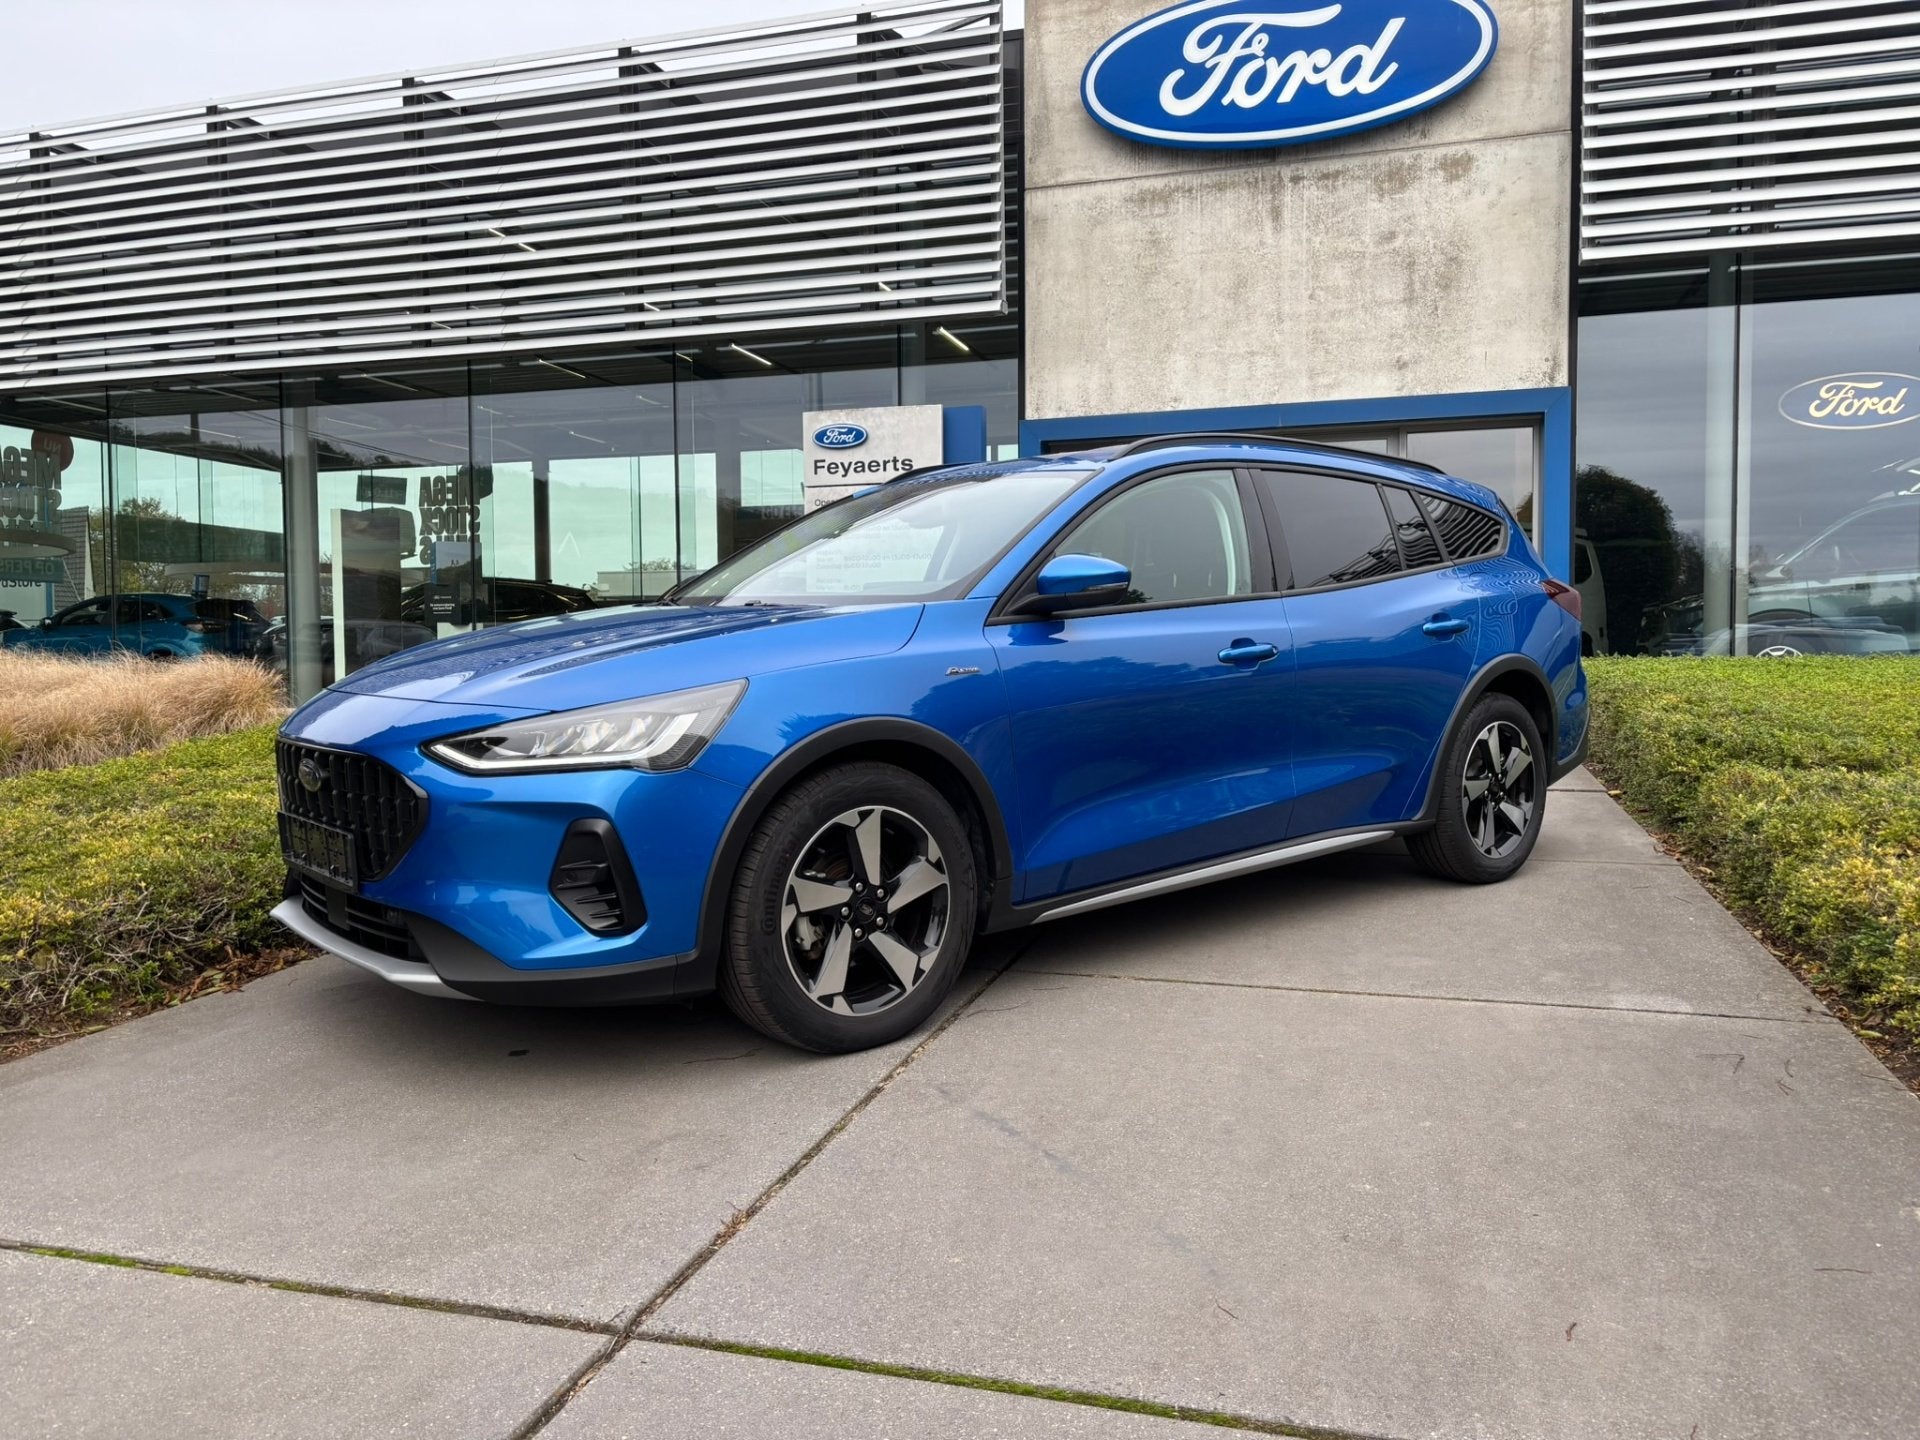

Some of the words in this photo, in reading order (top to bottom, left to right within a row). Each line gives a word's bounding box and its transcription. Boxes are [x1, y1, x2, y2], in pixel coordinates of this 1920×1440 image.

[1159, 4, 1406, 117] Ford
[1808, 381, 1909, 418] Ford
[823, 428, 857, 444] Ford
[813, 456, 914, 478] Feyaerts
